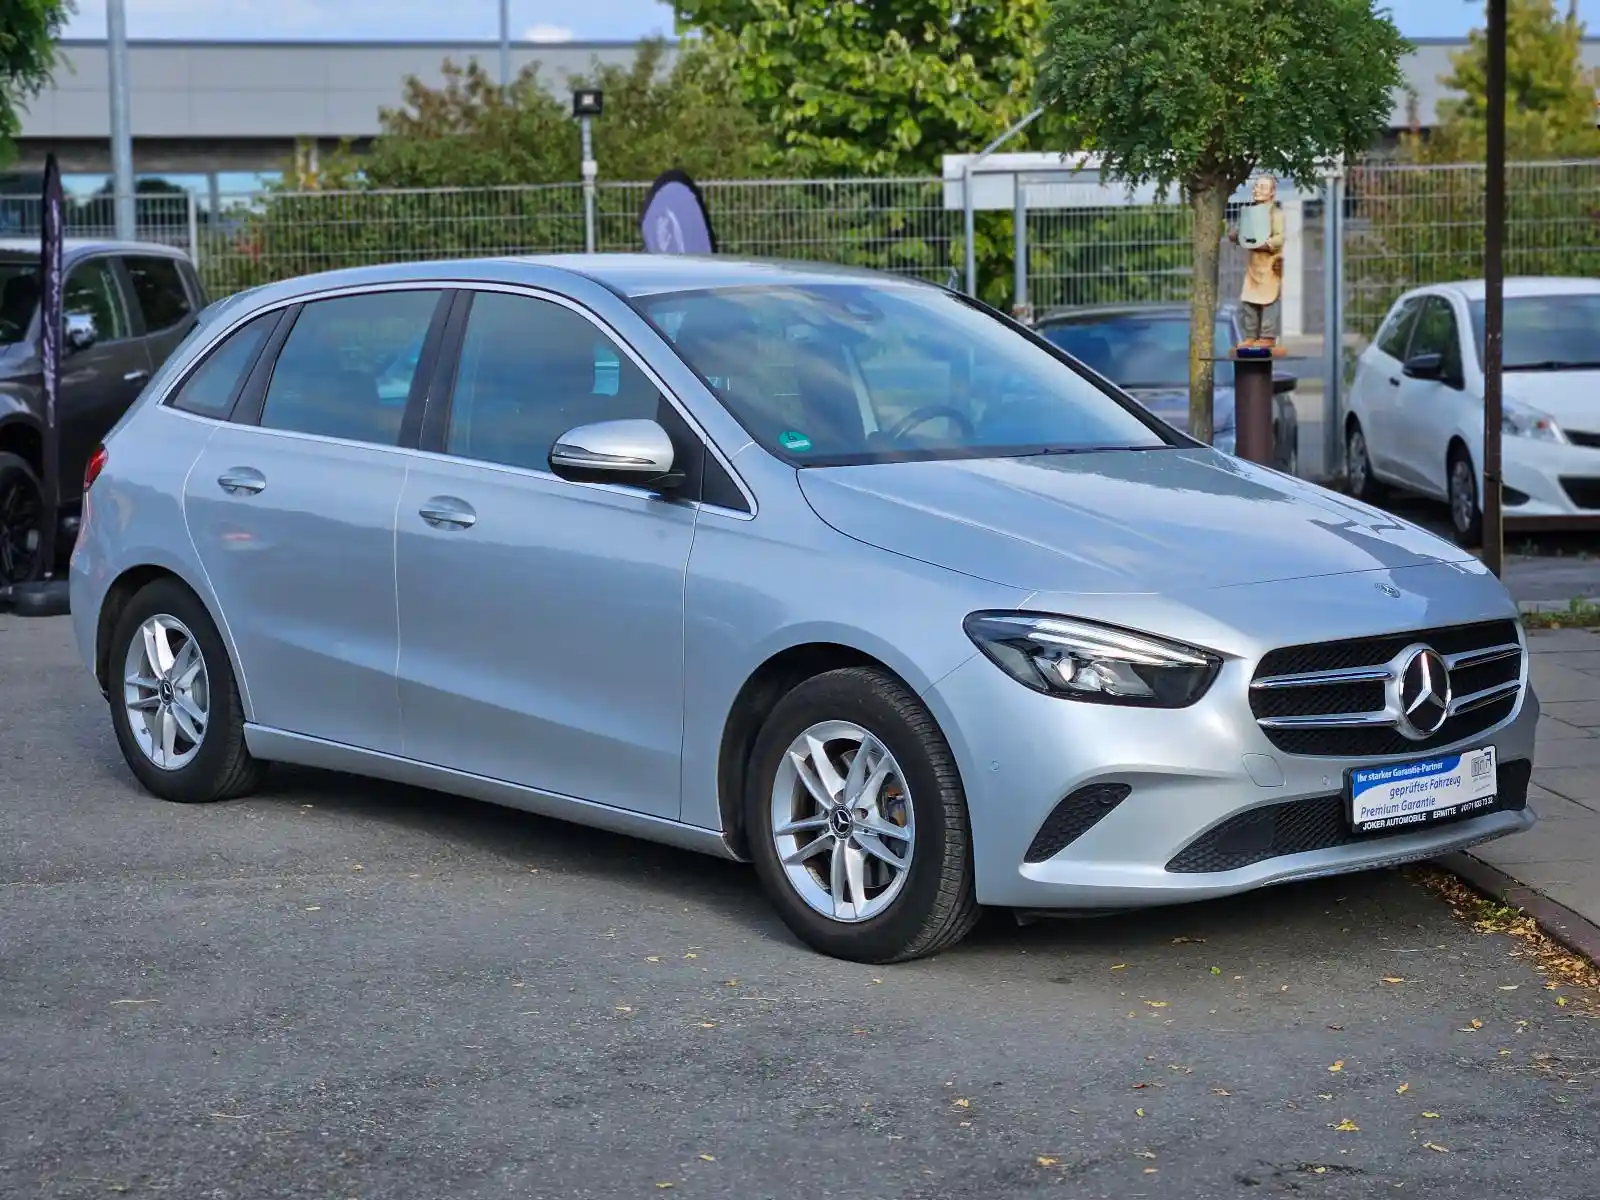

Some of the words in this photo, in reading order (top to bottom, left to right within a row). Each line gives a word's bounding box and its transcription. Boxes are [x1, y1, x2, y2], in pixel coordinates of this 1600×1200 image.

[1357, 773, 1367, 783] Ihr
[1368, 770, 1392, 781] starker
[1393, 761, 1444, 778] Garantie-Partner
[1389, 780, 1428, 800] geprüftes
[1429, 774, 1461, 790] Fahrzeug
[1360, 803, 1399, 819] Premium
[1401, 795, 1436, 812] Garantie
[1362, 819, 1386, 831] JOKER
[1386, 812, 1427, 827] AUTOMOBILE
[1433, 806, 1457, 819] ERWITTE
